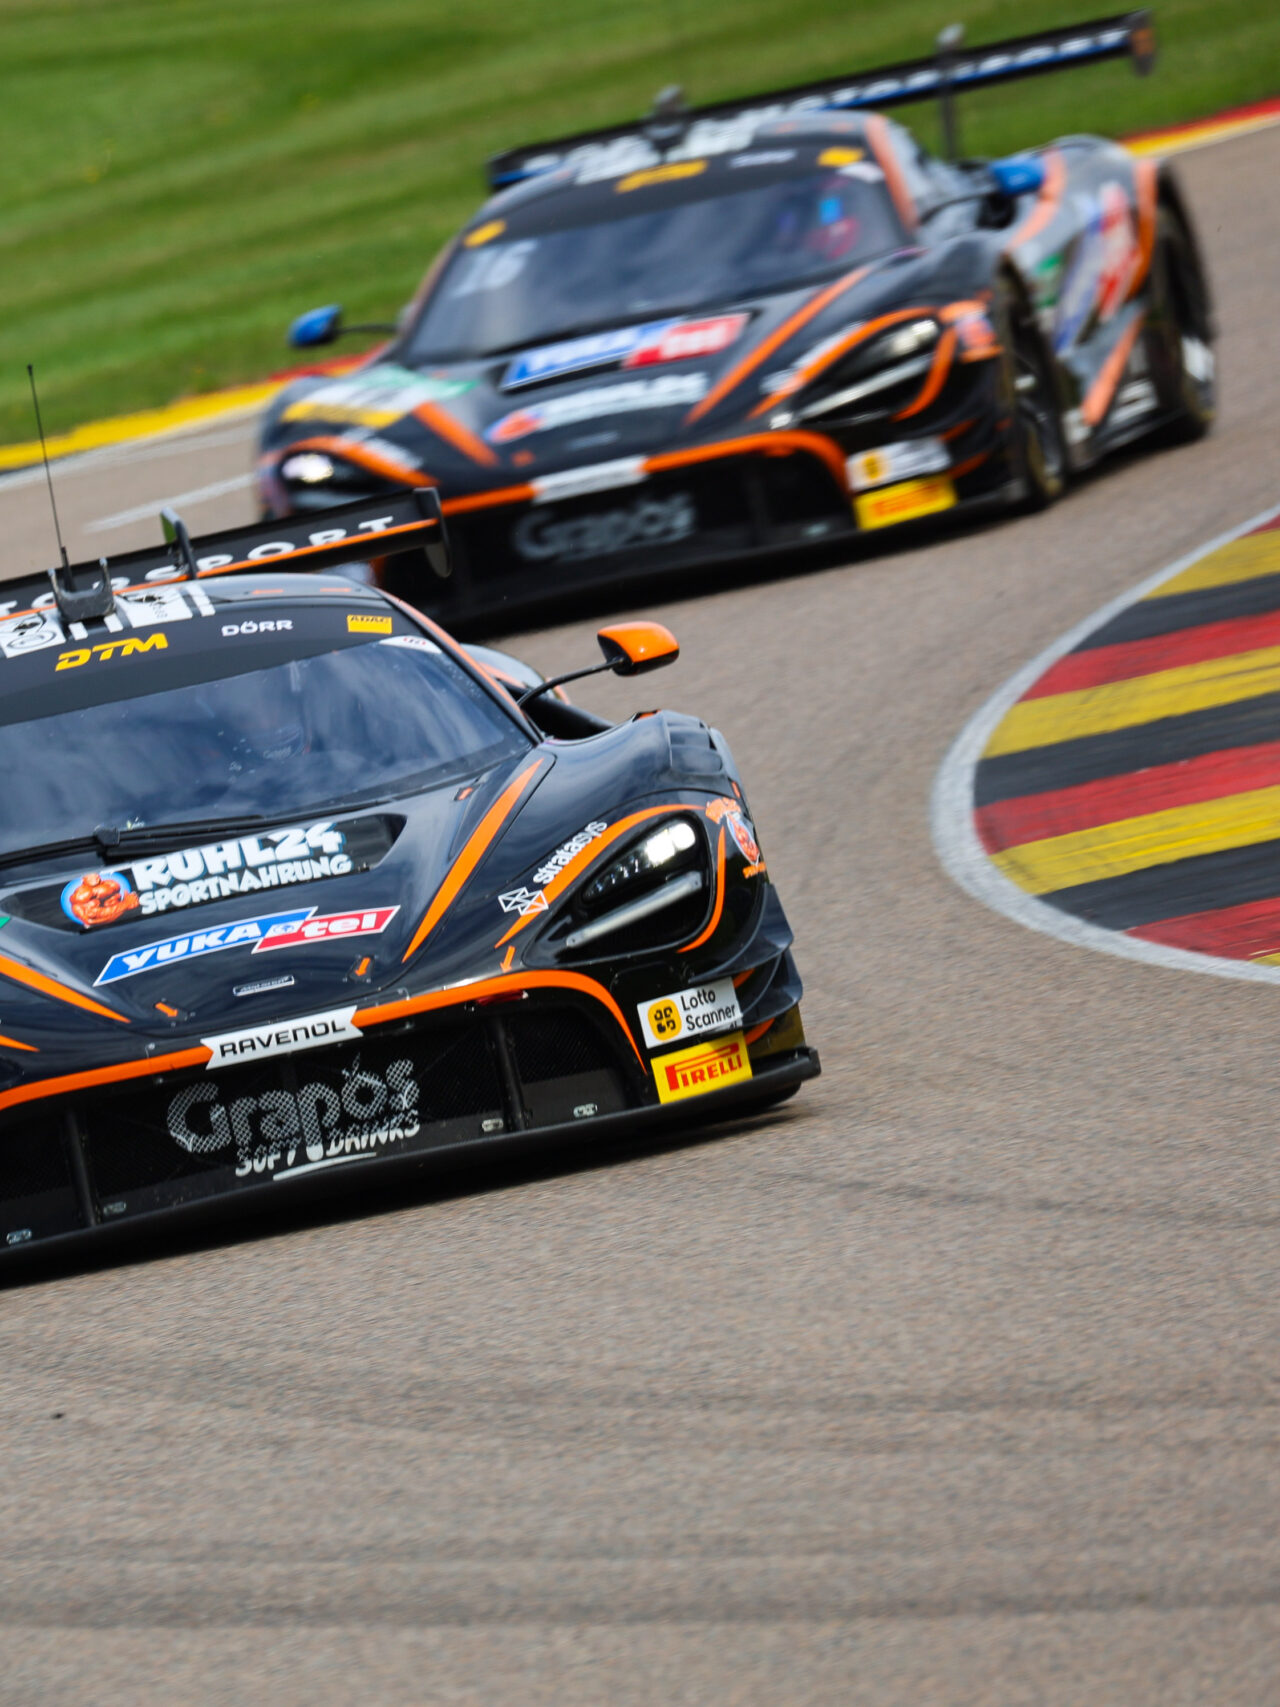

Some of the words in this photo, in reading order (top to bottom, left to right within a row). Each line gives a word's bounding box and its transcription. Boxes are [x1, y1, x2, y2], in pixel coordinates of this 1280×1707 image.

[221, 620, 293, 637] DÖRR
[55, 633, 168, 672] DTM
[533, 821, 607, 884] stratasys
[138, 854, 352, 915] SPORTNAHRUNG
[680, 988, 716, 1012] Lotto
[685, 1004, 736, 1031] Scanner
[219, 1019, 347, 1058] RAVENOL
[664, 1041, 743, 1091] PIRELLI
